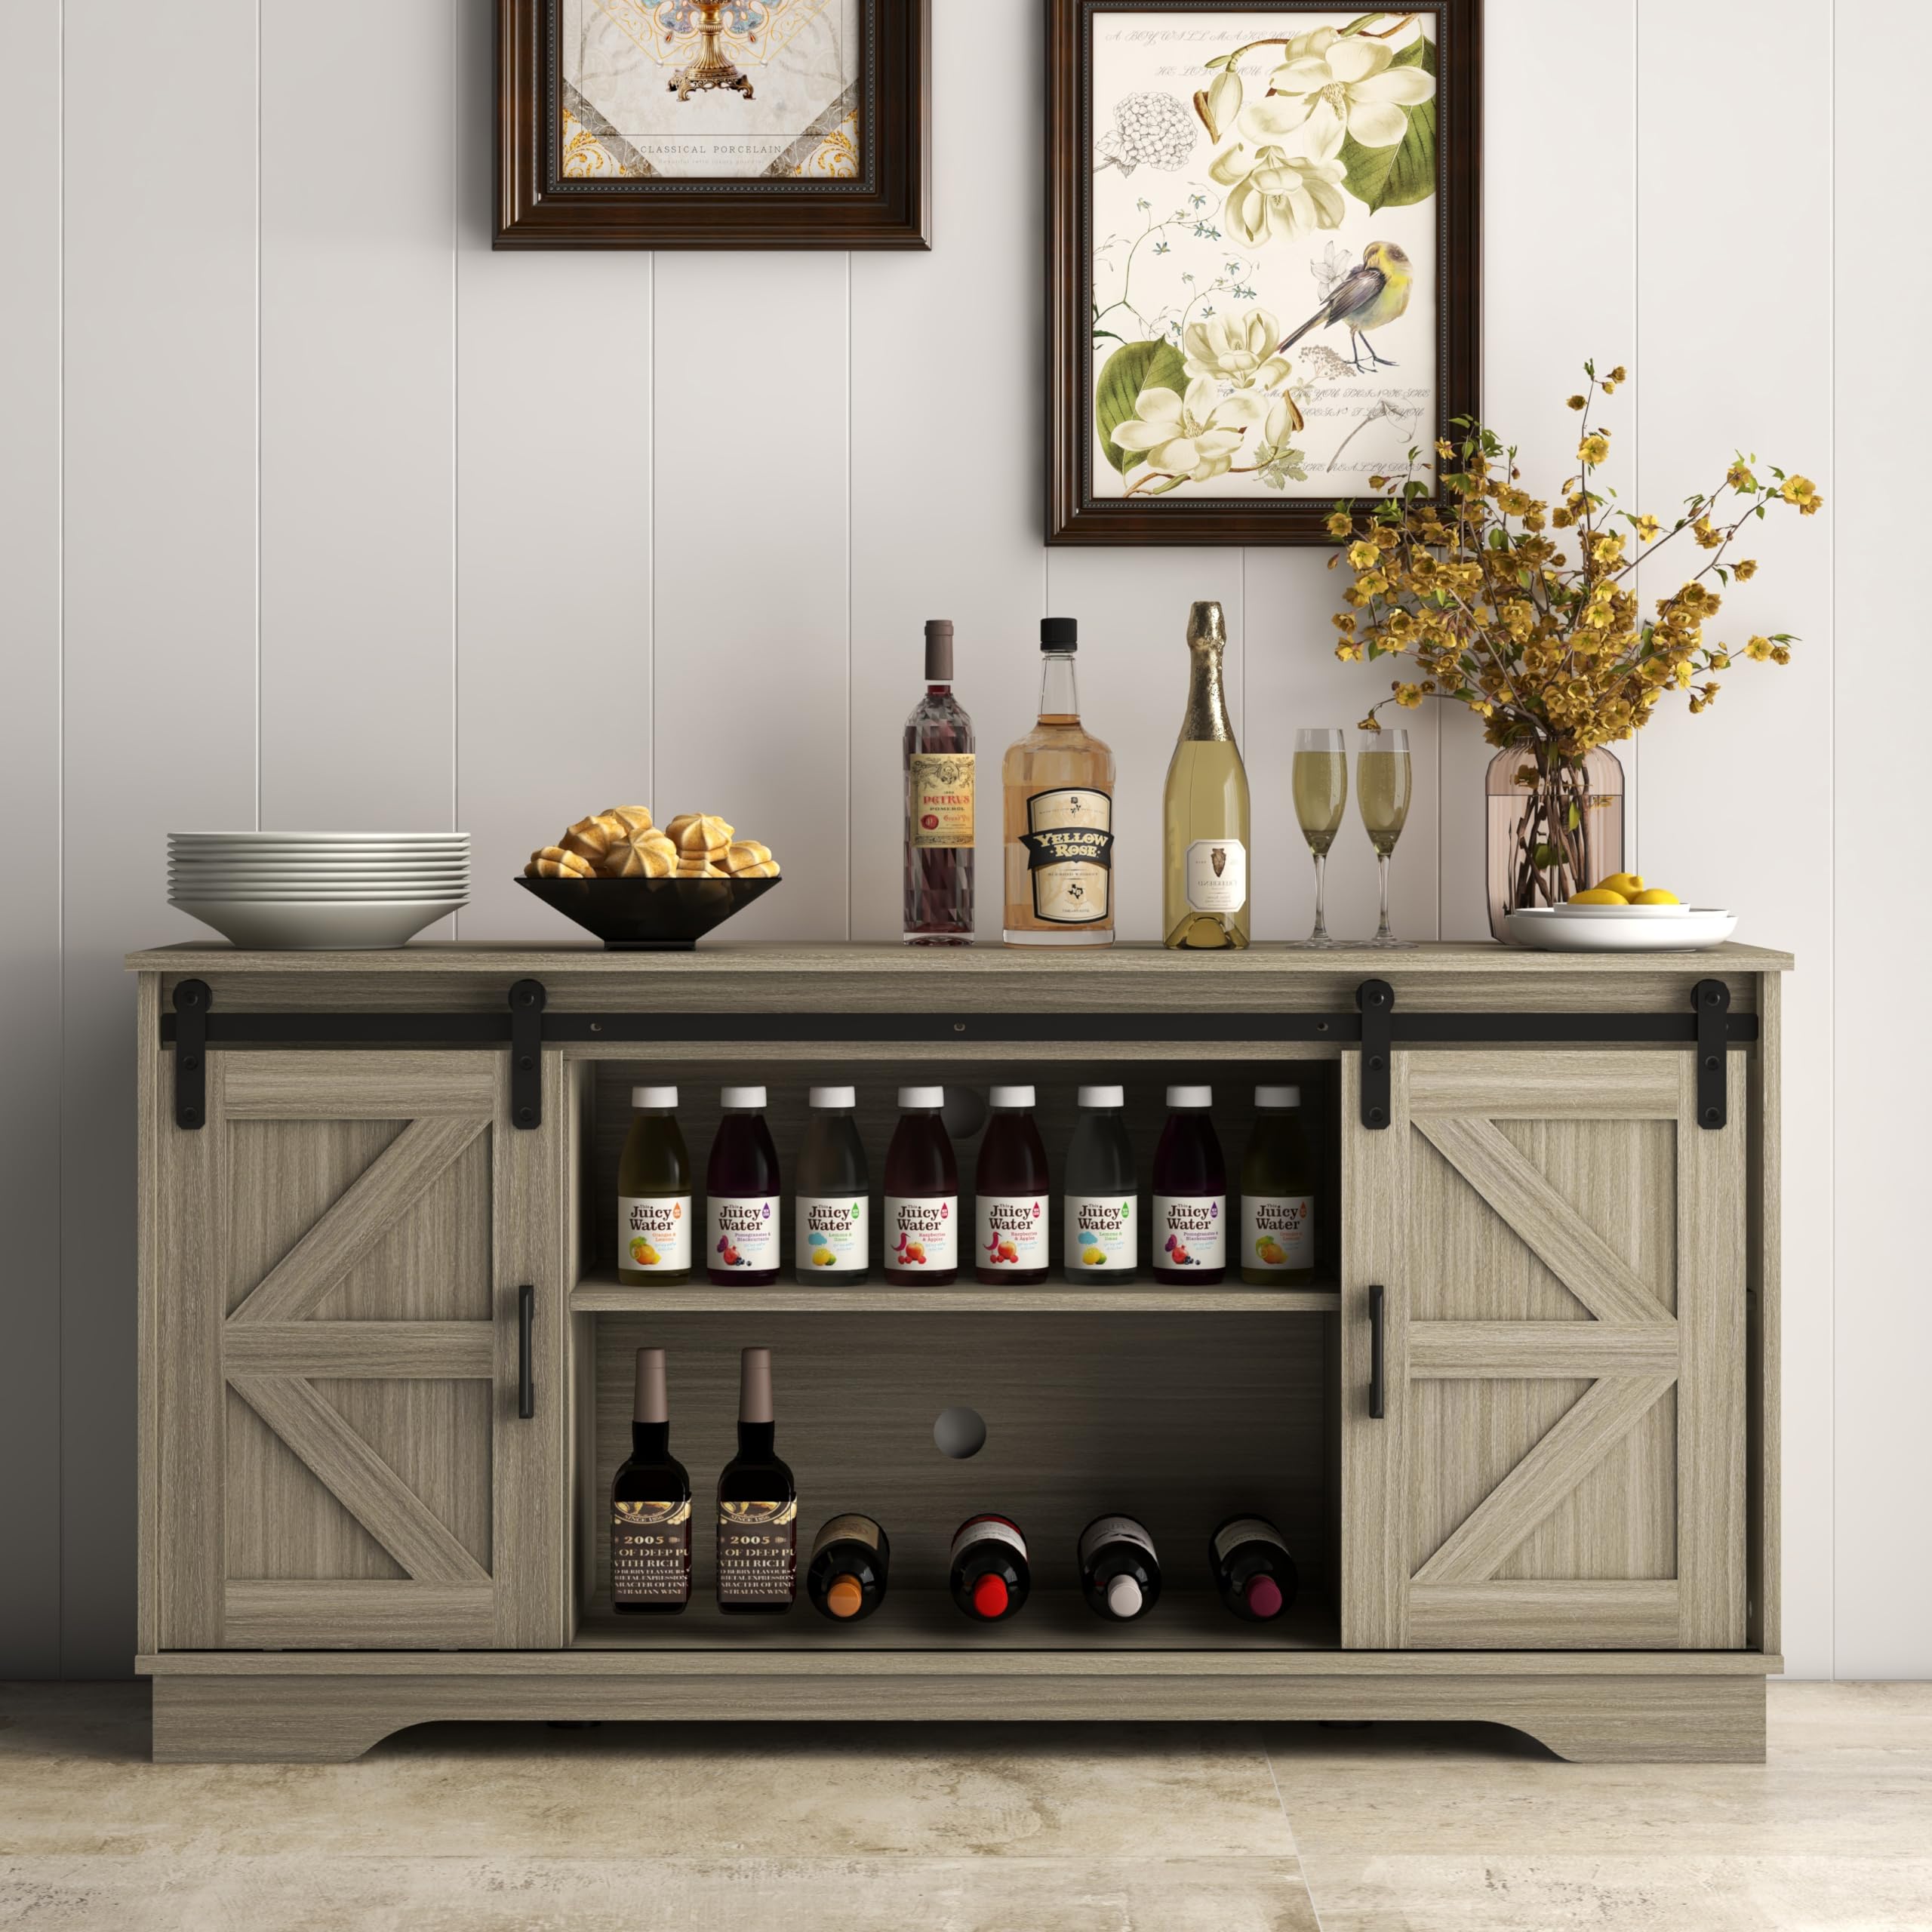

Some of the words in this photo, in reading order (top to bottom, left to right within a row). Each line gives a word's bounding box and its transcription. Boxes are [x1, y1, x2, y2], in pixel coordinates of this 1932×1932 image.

[1033, 832, 1109, 848] YELLOW
[1054, 844, 1097, 857] ROSE
[631, 1206, 672, 1220] Juicy
[720, 1206, 761, 1220] Juicy
[809, 1206, 850, 1220] Juicy
[898, 1206, 940, 1220] Juicy
[990, 1205, 1031, 1220] Juicy
[1079, 1205, 1120, 1220] Juicy
[1168, 1205, 1209, 1220] Juicy
[1257, 1205, 1298, 1220] Juicy
[629, 1219, 673, 1231] Water
[718, 1219, 763, 1231] Water
[808, 1219, 852, 1231] Water
[897, 1219, 941, 1231] Water
[989, 1218, 1033, 1230] Water
[1078, 1218, 1122, 1230] Water
[1167, 1218, 1211, 1230] Water
[1256, 1218, 1300, 1230] Water
[624, 1536, 664, 1544] 2005
[731, 1536, 771, 1544] 2005
